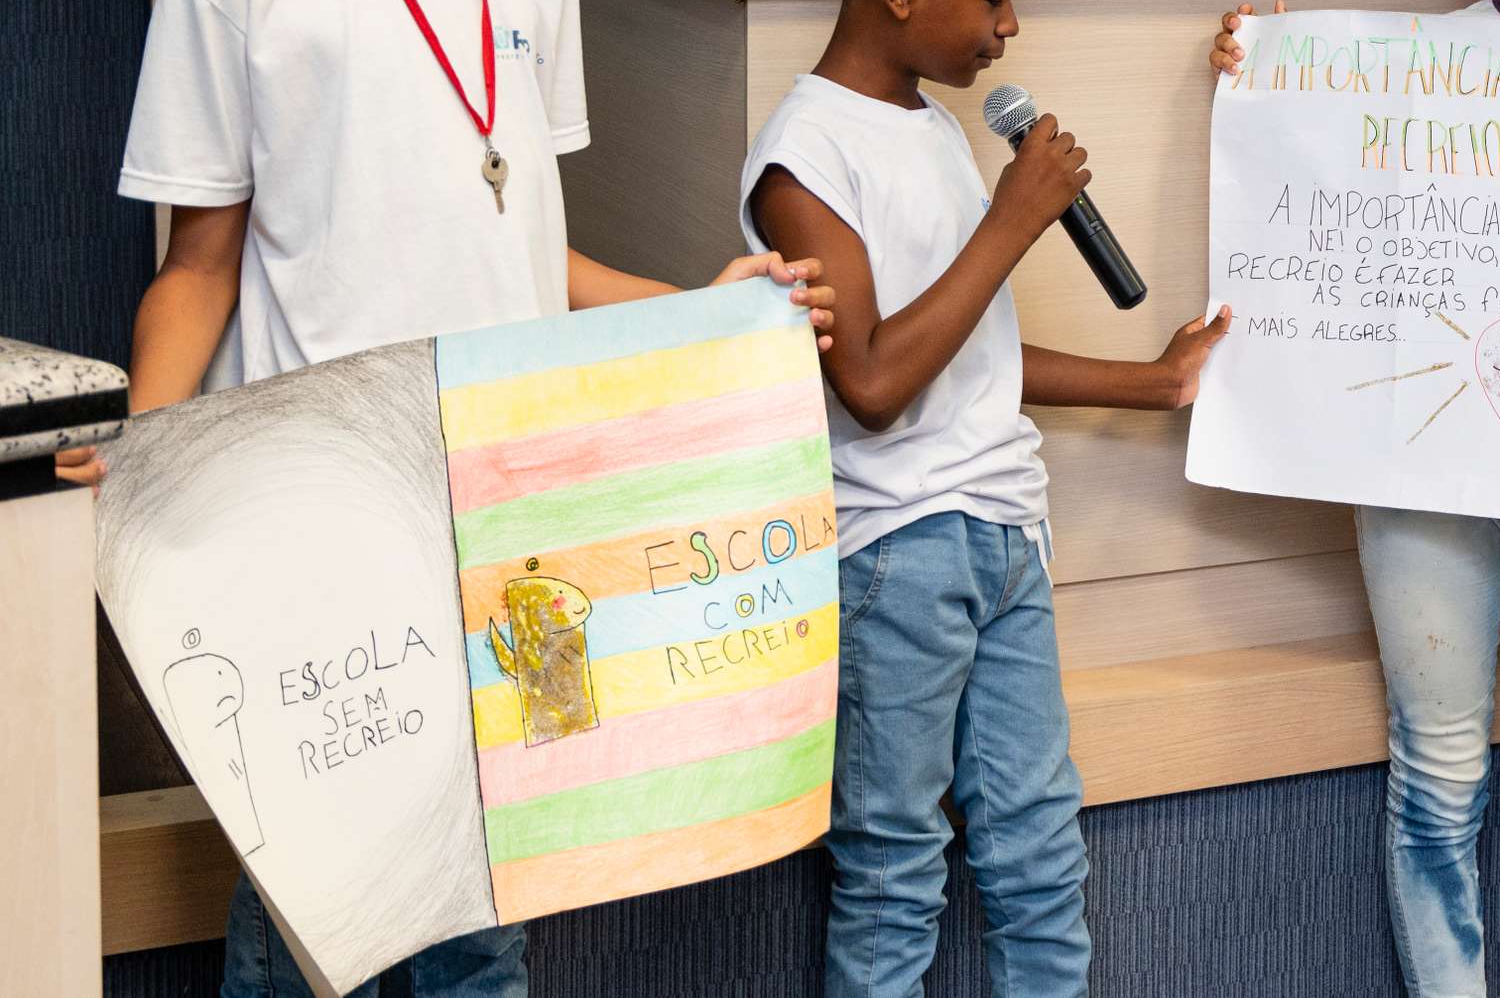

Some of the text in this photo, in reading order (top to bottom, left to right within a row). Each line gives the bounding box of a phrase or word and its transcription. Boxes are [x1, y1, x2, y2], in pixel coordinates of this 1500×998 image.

[1268, 184, 1290, 224] A
[1309, 182, 1500, 237] IMPORTÂNCIA
[1309, 228, 1344, 252] NE!
[1356, 236, 1372, 253] O
[1228, 253, 1455, 286] RECREIO É FAZER
[1248, 312, 1298, 339] MAIS
[1312, 284, 1341, 306] AS
[1361, 288, 1466, 318] CRIANÇAS
[645, 514, 834, 594] ESCOLA
[704, 578, 793, 629] COM
[279, 626, 436, 706] ESCOLA
[666, 619, 809, 685] RECREIO
[323, 687, 388, 735] SEM
[298, 709, 424, 779] RECREIO
